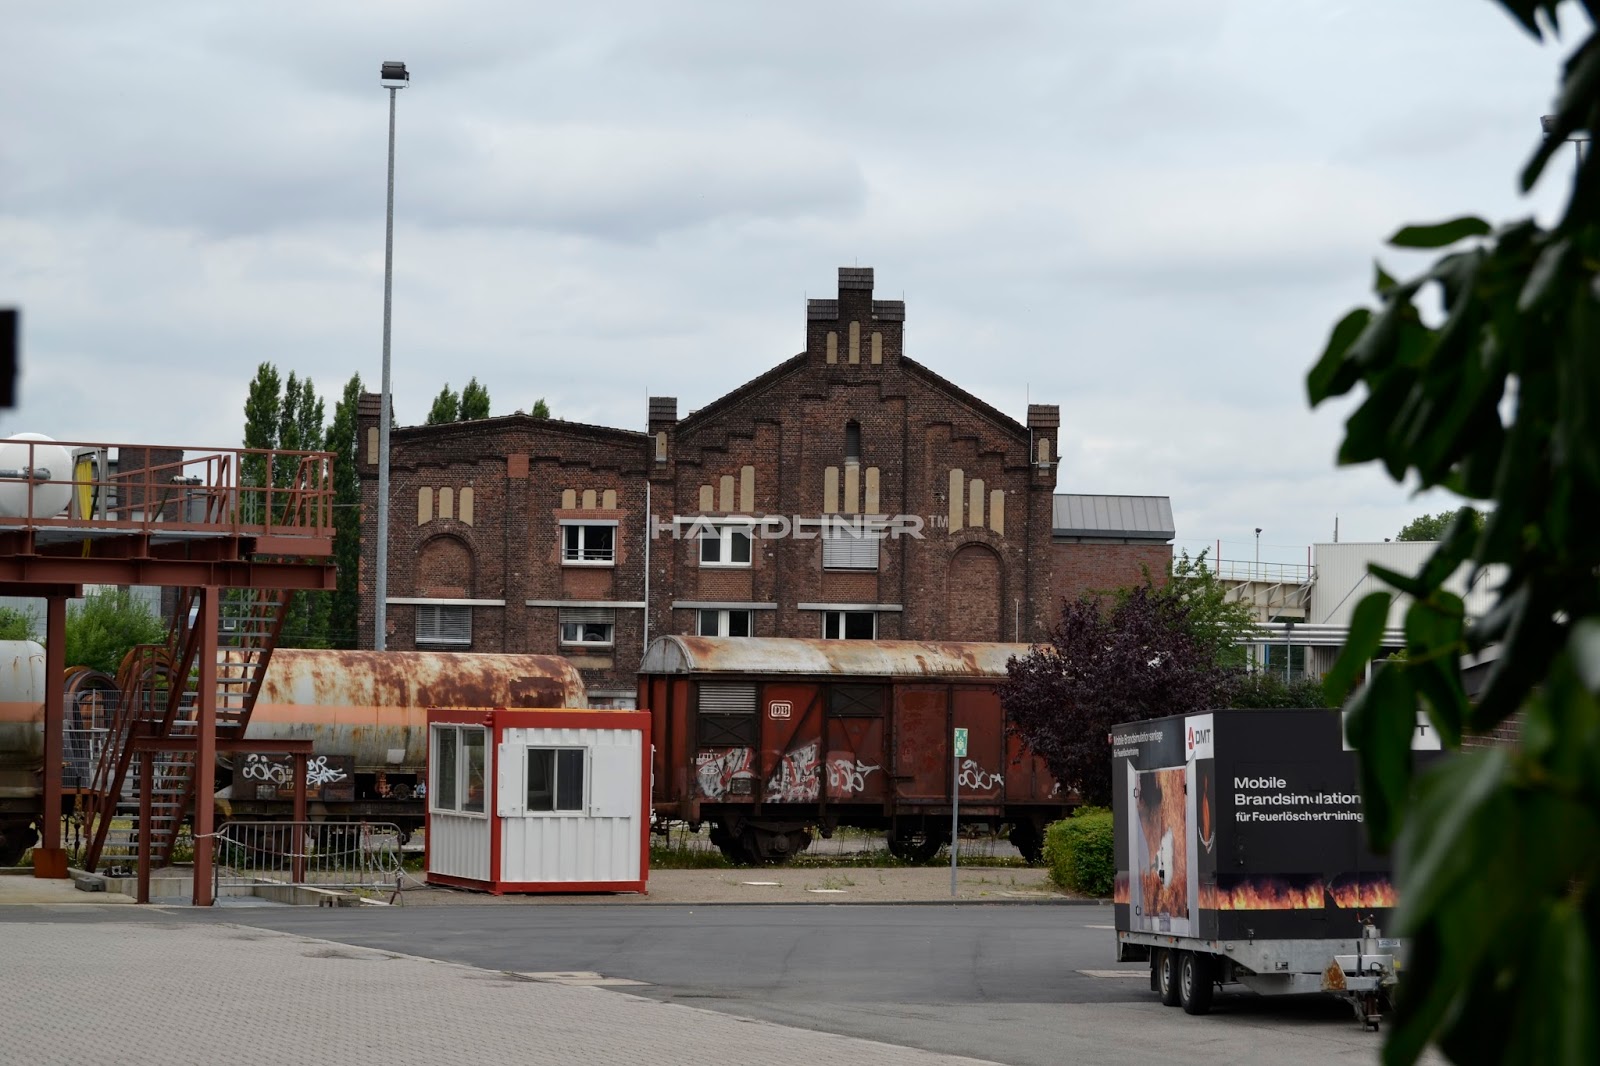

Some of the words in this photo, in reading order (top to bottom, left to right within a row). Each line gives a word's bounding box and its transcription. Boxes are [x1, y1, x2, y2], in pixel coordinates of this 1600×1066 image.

[1195, 729, 1211, 744] DMT
[1234, 776, 1287, 789] Mobile
[1234, 792, 1362, 806] Brandsimulation
[1235, 811, 1251, 822] für
